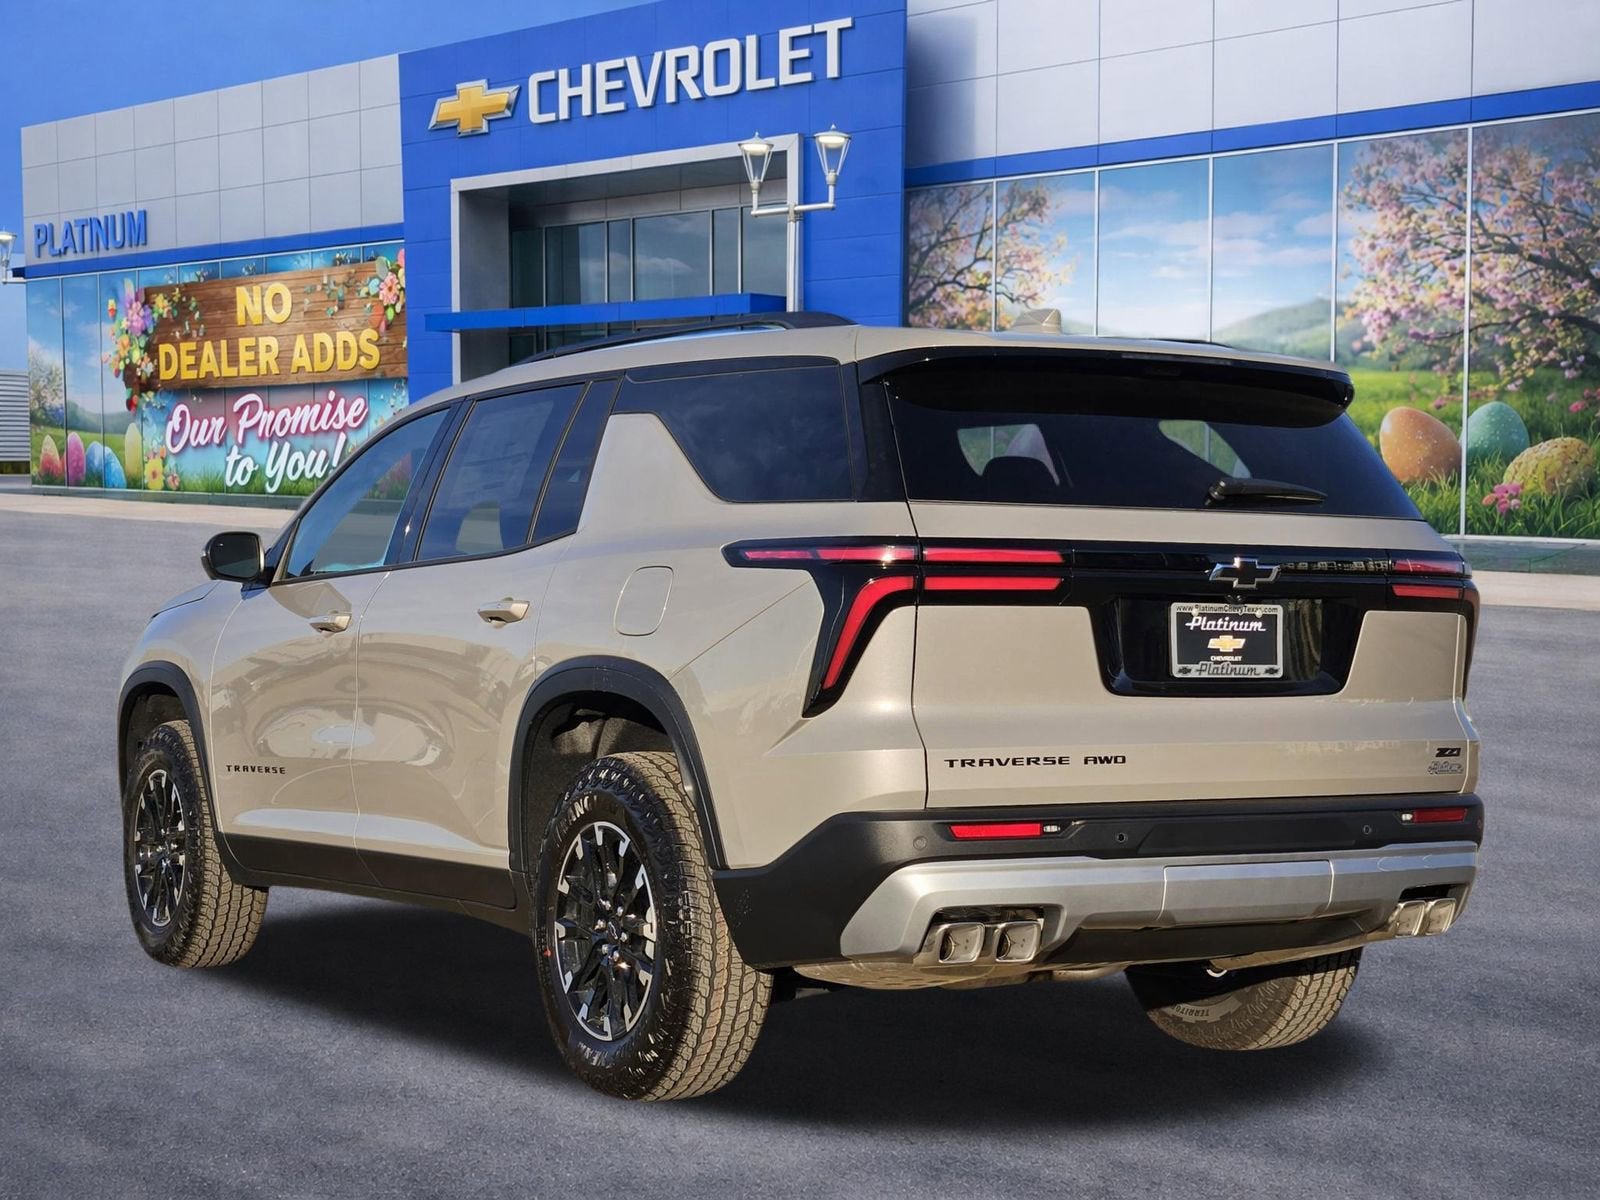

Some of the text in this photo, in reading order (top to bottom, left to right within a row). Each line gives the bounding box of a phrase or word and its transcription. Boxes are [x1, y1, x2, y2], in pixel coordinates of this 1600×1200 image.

[528, 16, 854, 125] CHEVROLET
[34, 210, 147, 258] PLATINUM
[235, 282, 293, 326] NO
[158, 328, 382, 382] DEALER ADDS
[165, 390, 370, 456] Our Promise
[225, 432, 347, 494] to You!
[1185, 616, 1267, 631] Platinum
[1196, 661, 1261, 676] Platinum
[225, 764, 286, 775] TRAVERSE
[944, 755, 1127, 768] TRAVERSE AWD
